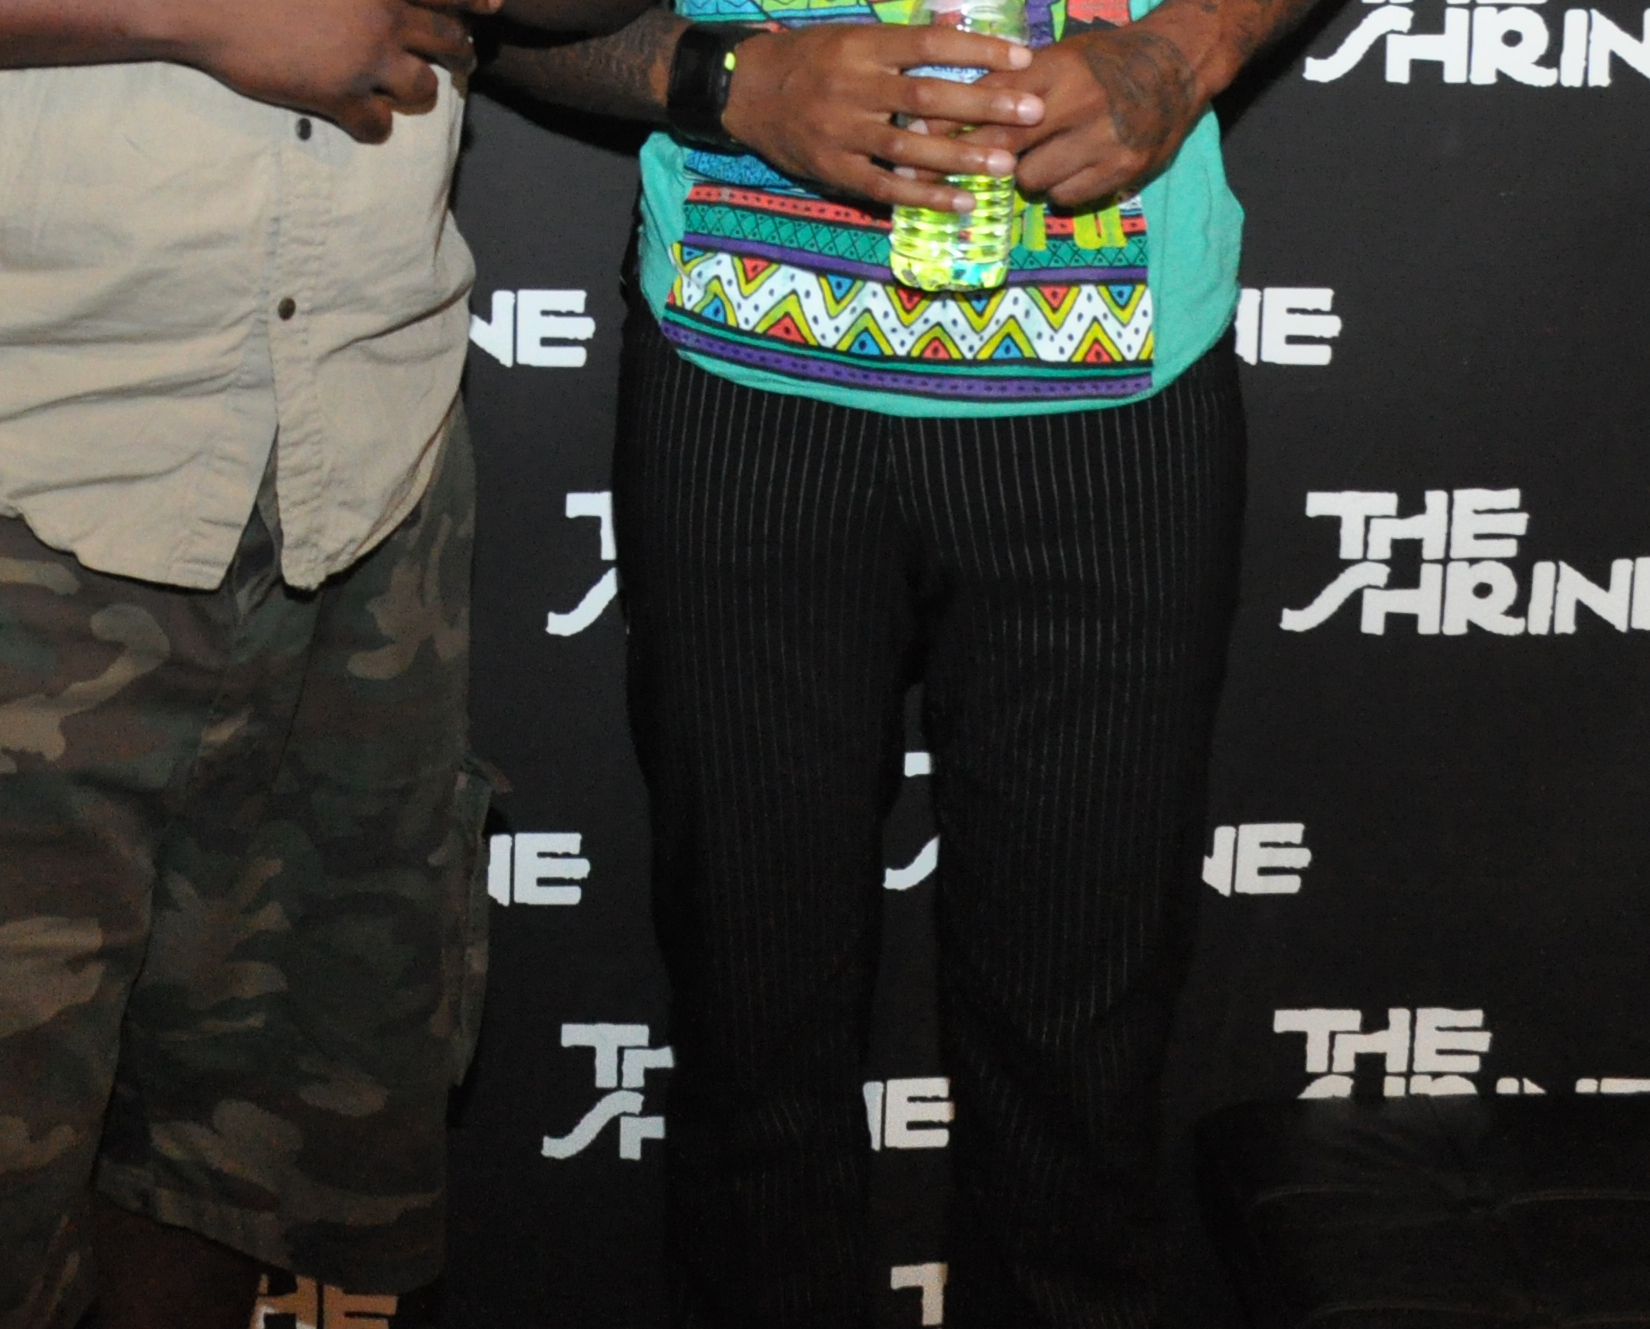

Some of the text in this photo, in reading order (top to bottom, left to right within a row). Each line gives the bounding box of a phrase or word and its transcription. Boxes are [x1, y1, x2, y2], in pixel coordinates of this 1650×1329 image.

[1302, 4, 1650, 88] SHRIN
[1305, 488, 1529, 561] THE
[1280, 556, 1650, 636] SHRIN
[1273, 1007, 1491, 1073] THE
